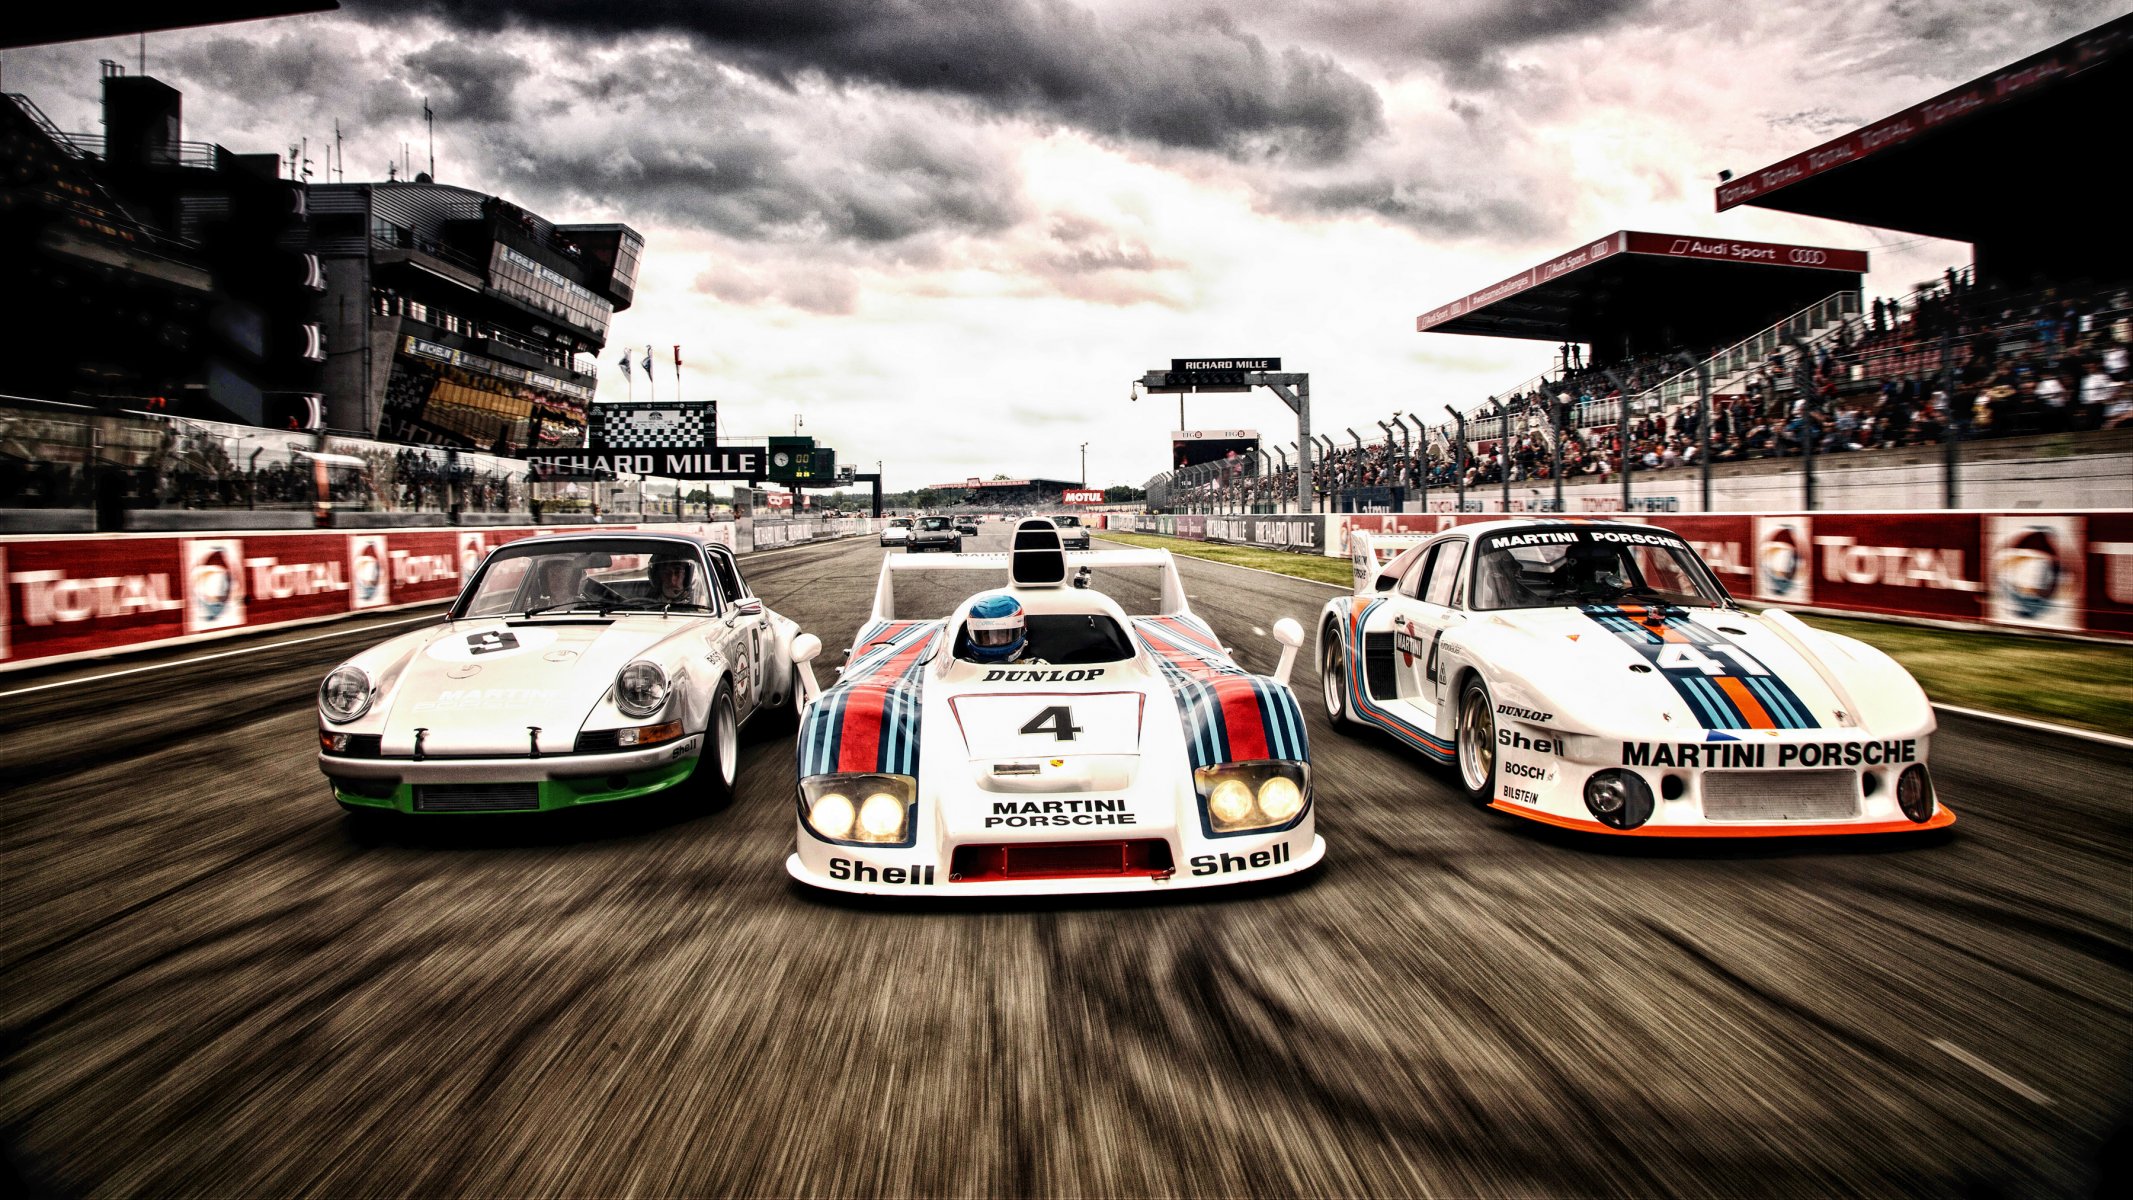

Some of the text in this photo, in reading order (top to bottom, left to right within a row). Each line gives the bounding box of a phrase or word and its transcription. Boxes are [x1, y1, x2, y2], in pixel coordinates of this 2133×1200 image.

[1859, 119, 1915, 149] TOTAL
[1808, 143, 1856, 169] TOTAL
[1760, 164, 1803, 188] TOTAL
[1719, 182, 1757, 205] TOTAL
[1551, 252, 1586, 273] Audi Sport
[1691, 241, 1776, 260] Audi Sport
[1185, 360, 1268, 370] RICHARD MILLE
[526, 453, 756, 474] RICHARD MILLE
[1064, 493, 1102, 502] MOTUL
[1206, 519, 1229, 539] RICHARD
[1229, 521, 1247, 541] MILLE
[1255, 521, 1315, 547] RICHARD MILLE
[1492, 531, 1684, 550] MARTINI PORSCHE
[389, 550, 458, 588] TOTAL
[1815, 535, 1984, 591] TOTAL
[246, 557, 350, 600] TOTAL
[9, 569, 185, 626] TOTAL
[1396, 632, 1421, 656] MARTINI
[752, 627, 761, 687] 9
[1655, 643, 1771, 676] 41
[983, 669, 1105, 682] DUNLOP
[1017, 705, 1084, 742] 4
[1496, 704, 1553, 722] DUNLOP
[672, 738, 697, 759] Shell
[1498, 728, 1565, 757] Shell
[1622, 739, 1916, 768] MARTINI PORSCHE
[1505, 761, 1546, 780] BOSCH
[993, 799, 1126, 815] MARTINI
[1503, 785, 1539, 805] BILSTEIN
[985, 813, 1137, 828] PORSCHE
[829, 858, 935, 885] Shell
[1191, 842, 1291, 878] Shell
